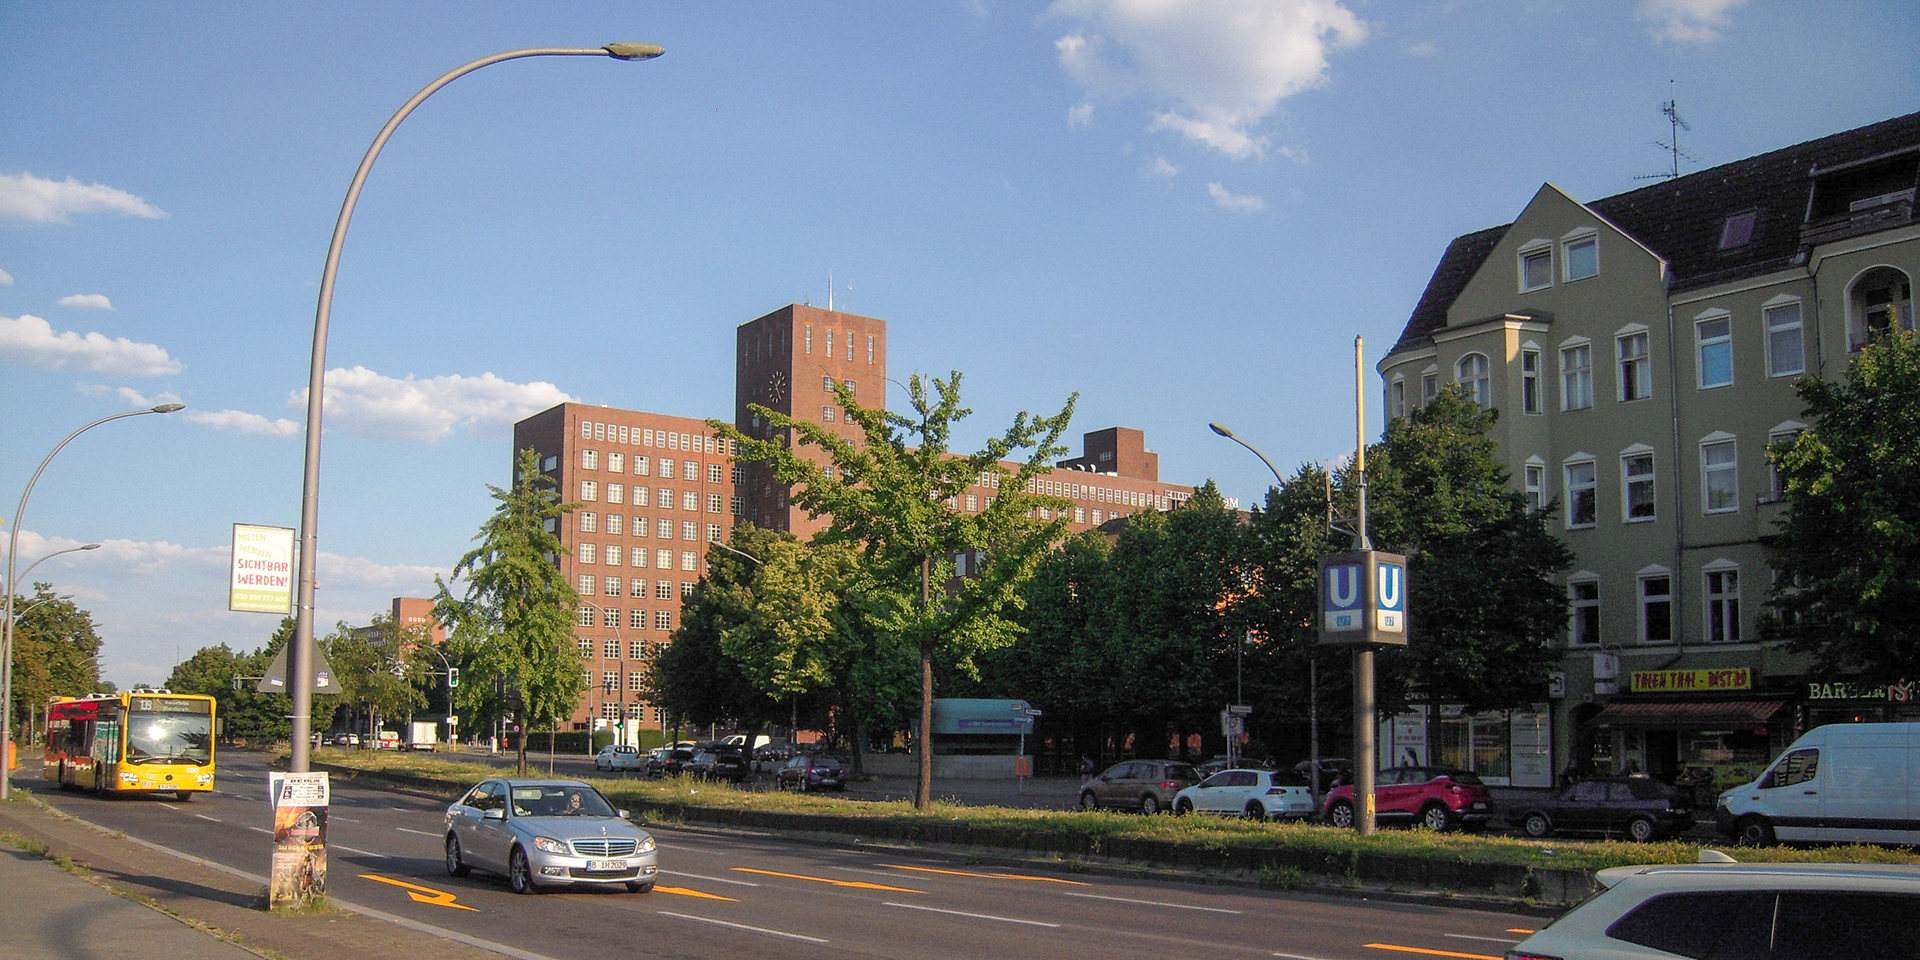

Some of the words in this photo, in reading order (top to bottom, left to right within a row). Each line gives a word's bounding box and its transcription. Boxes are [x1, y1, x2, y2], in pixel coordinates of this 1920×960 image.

[237, 533, 266, 542] MIETEN
[237, 558, 288, 572] SICHTBAR
[237, 573, 288, 587] WERDEN!
[1329, 566, 1357, 608] U
[1379, 566, 1399, 608] U
[1385, 617, 1394, 626] U7
[1670, 672, 1696, 688] THAI
[1708, 670, 1747, 687] BISTRO
